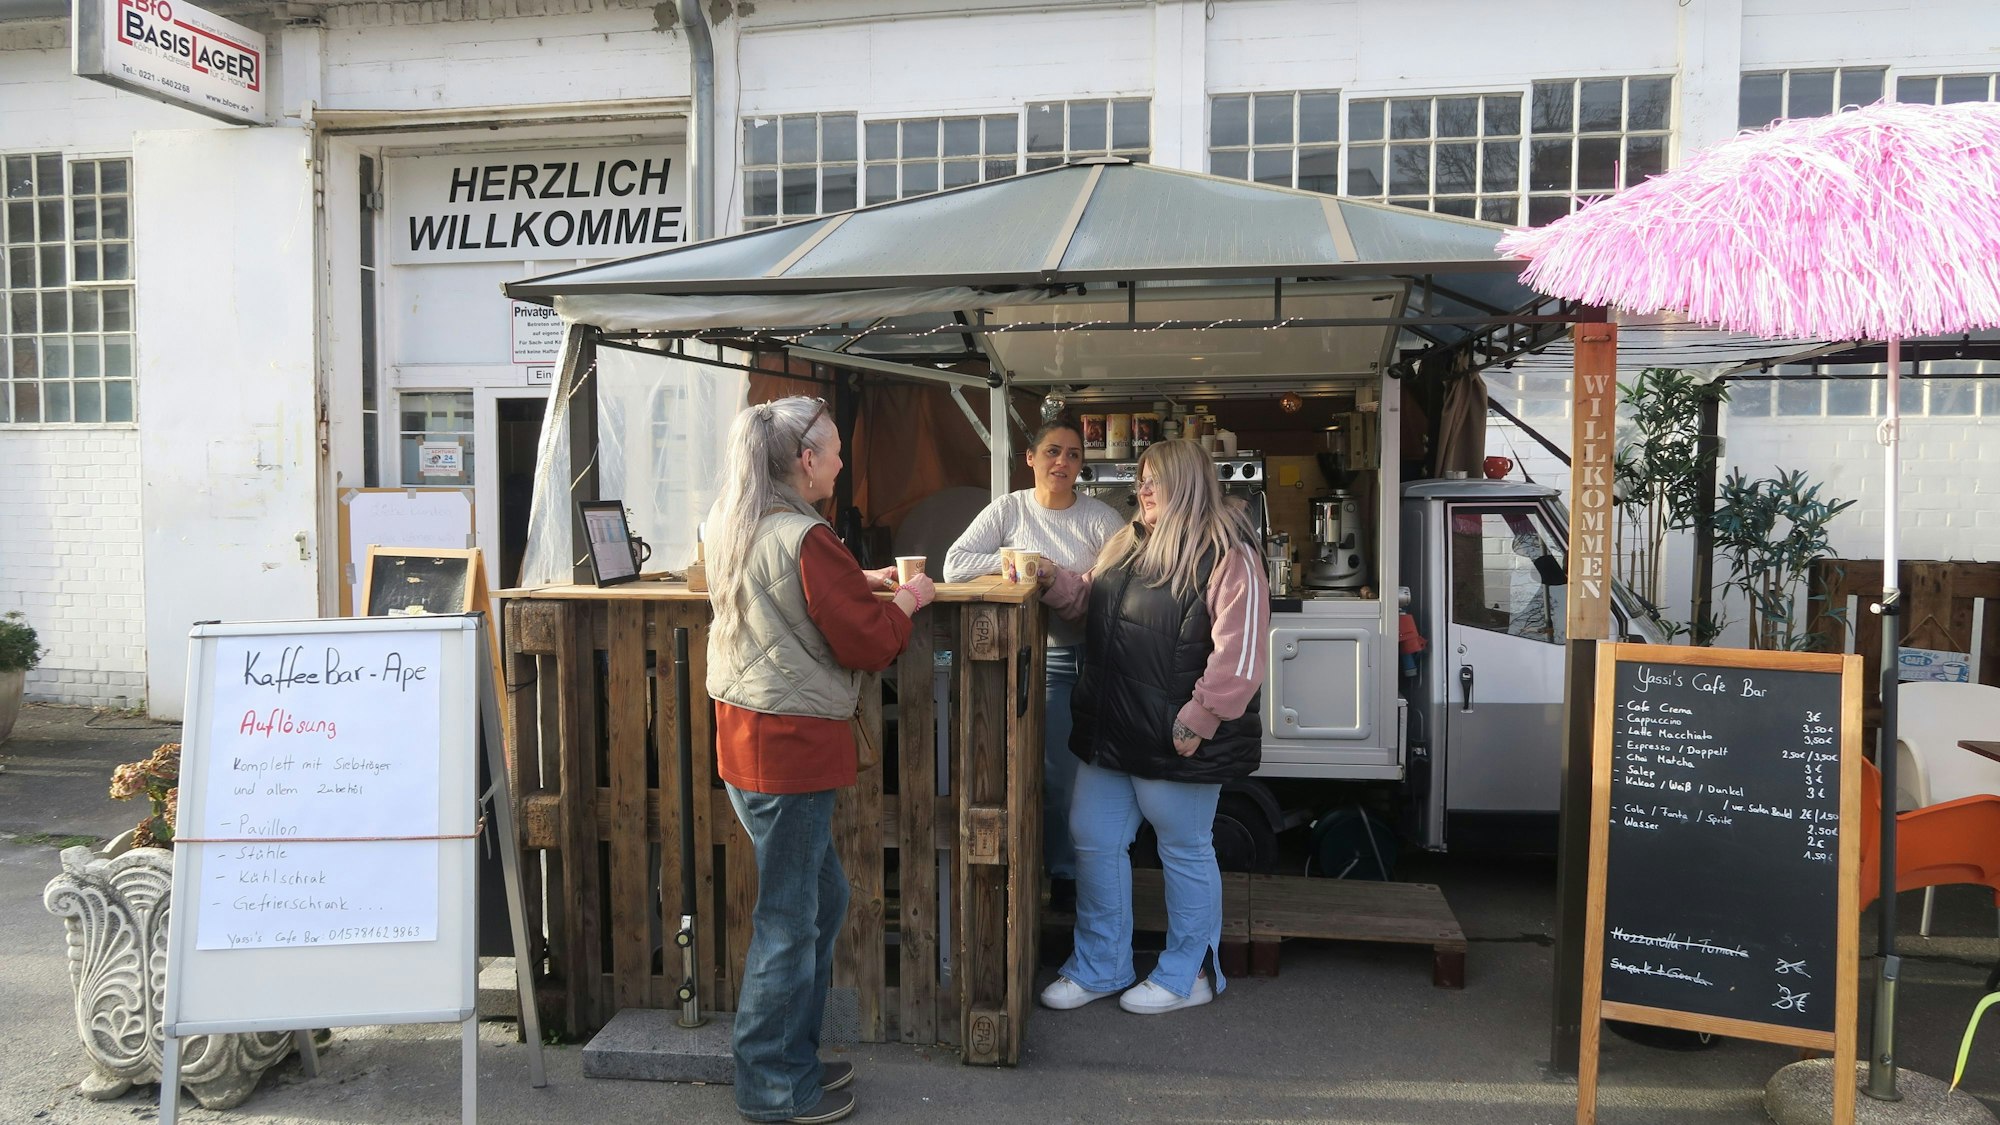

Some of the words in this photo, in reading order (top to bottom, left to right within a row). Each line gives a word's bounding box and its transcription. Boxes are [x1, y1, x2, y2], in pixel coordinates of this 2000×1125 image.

[133, 41, 152, 56] Kölns
[162, 53, 191, 69] Adresse
[209, 69, 219, 79] für
[228, 76, 246, 88] Hand
[138, 69, 155, 81] 0221
[449, 158, 672, 203] HERZLICH
[409, 206, 687, 251] WILLKOMME
[536, 370, 554, 380] Ein
[1580, 375, 1610, 599] WILLKOMMEN
[976, 620, 989, 650] EPAL
[1632, 665, 1683, 693] Yassi's
[1740, 678, 1768, 697] Bar
[1659, 703, 1693, 715] Crema
[1627, 713, 1682, 726] Cappuccino
[1628, 726, 1653, 737] Latte
[1658, 729, 1713, 740] Macchiato
[1627, 740, 1671, 752] Espresso
[1686, 746, 1729, 759] Doppelt
[233, 754, 295, 779] Komplett
[302, 757, 322, 770] mit
[1626, 753, 1648, 762] Chai
[1657, 755, 1695, 768] Matcha
[1627, 765, 1656, 779] Salep
[234, 782, 256, 795] und
[266, 783, 298, 795] allem
[1625, 776, 1656, 789] Kakao
[1707, 785, 1744, 797] Dunkel
[1624, 804, 1645, 815] Cola
[1660, 807, 1689, 820] Fanta
[1705, 814, 1733, 825] Sprite
[1624, 816, 1659, 830] Wasser
[239, 813, 298, 836] Pavillon
[235, 845, 288, 860] Stühle
[233, 893, 350, 912] Gefrierschrank
